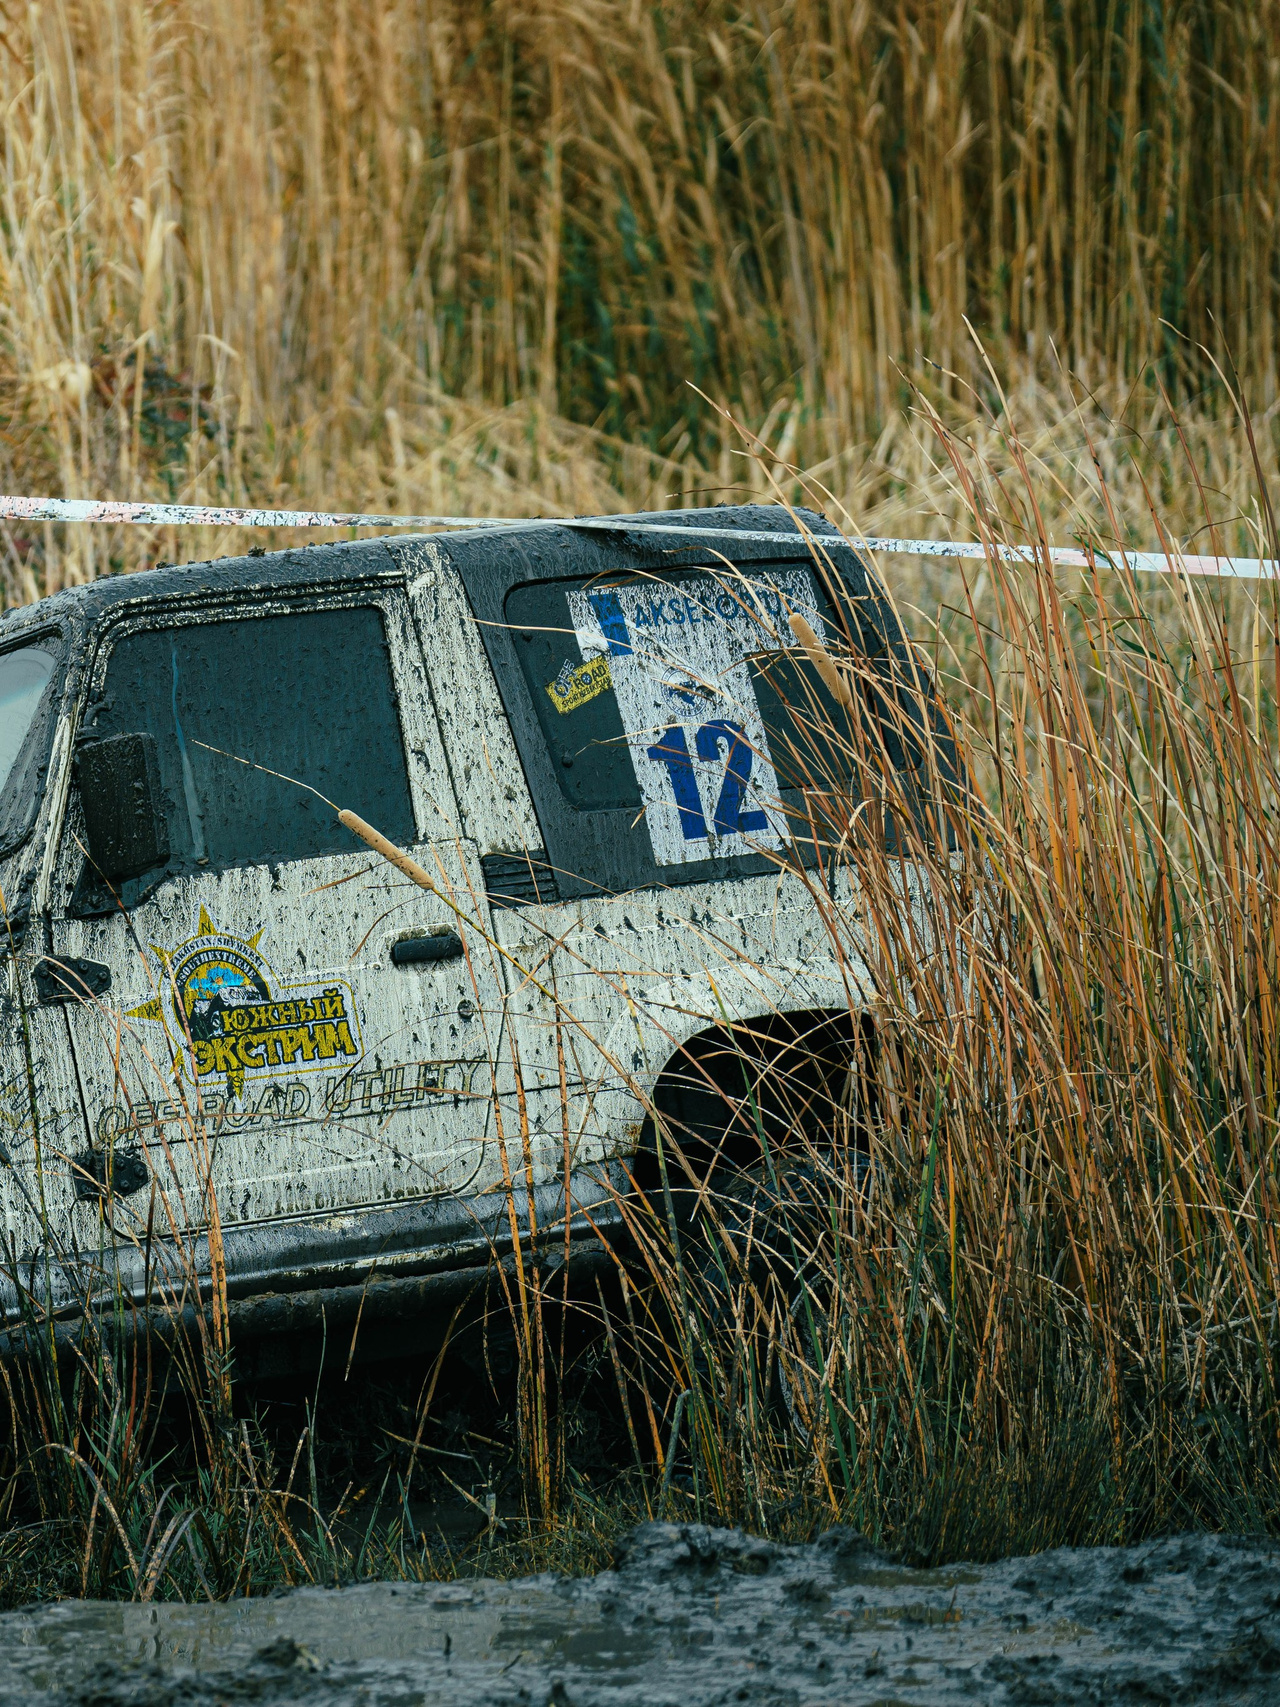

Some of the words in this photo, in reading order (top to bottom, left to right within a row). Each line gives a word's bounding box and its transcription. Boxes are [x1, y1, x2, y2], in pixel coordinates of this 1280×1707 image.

[573, 665, 606, 690] ROAD
[646, 718, 769, 840] 12
[220, 989, 347, 1033] ЮЖНЫЙ
[192, 1020, 358, 1077] ЭКСТРИМ
[97, 1099, 182, 1143] OFF
[194, 1082, 310, 1133] ROAD
[325, 1053, 487, 1113] UTILITY
